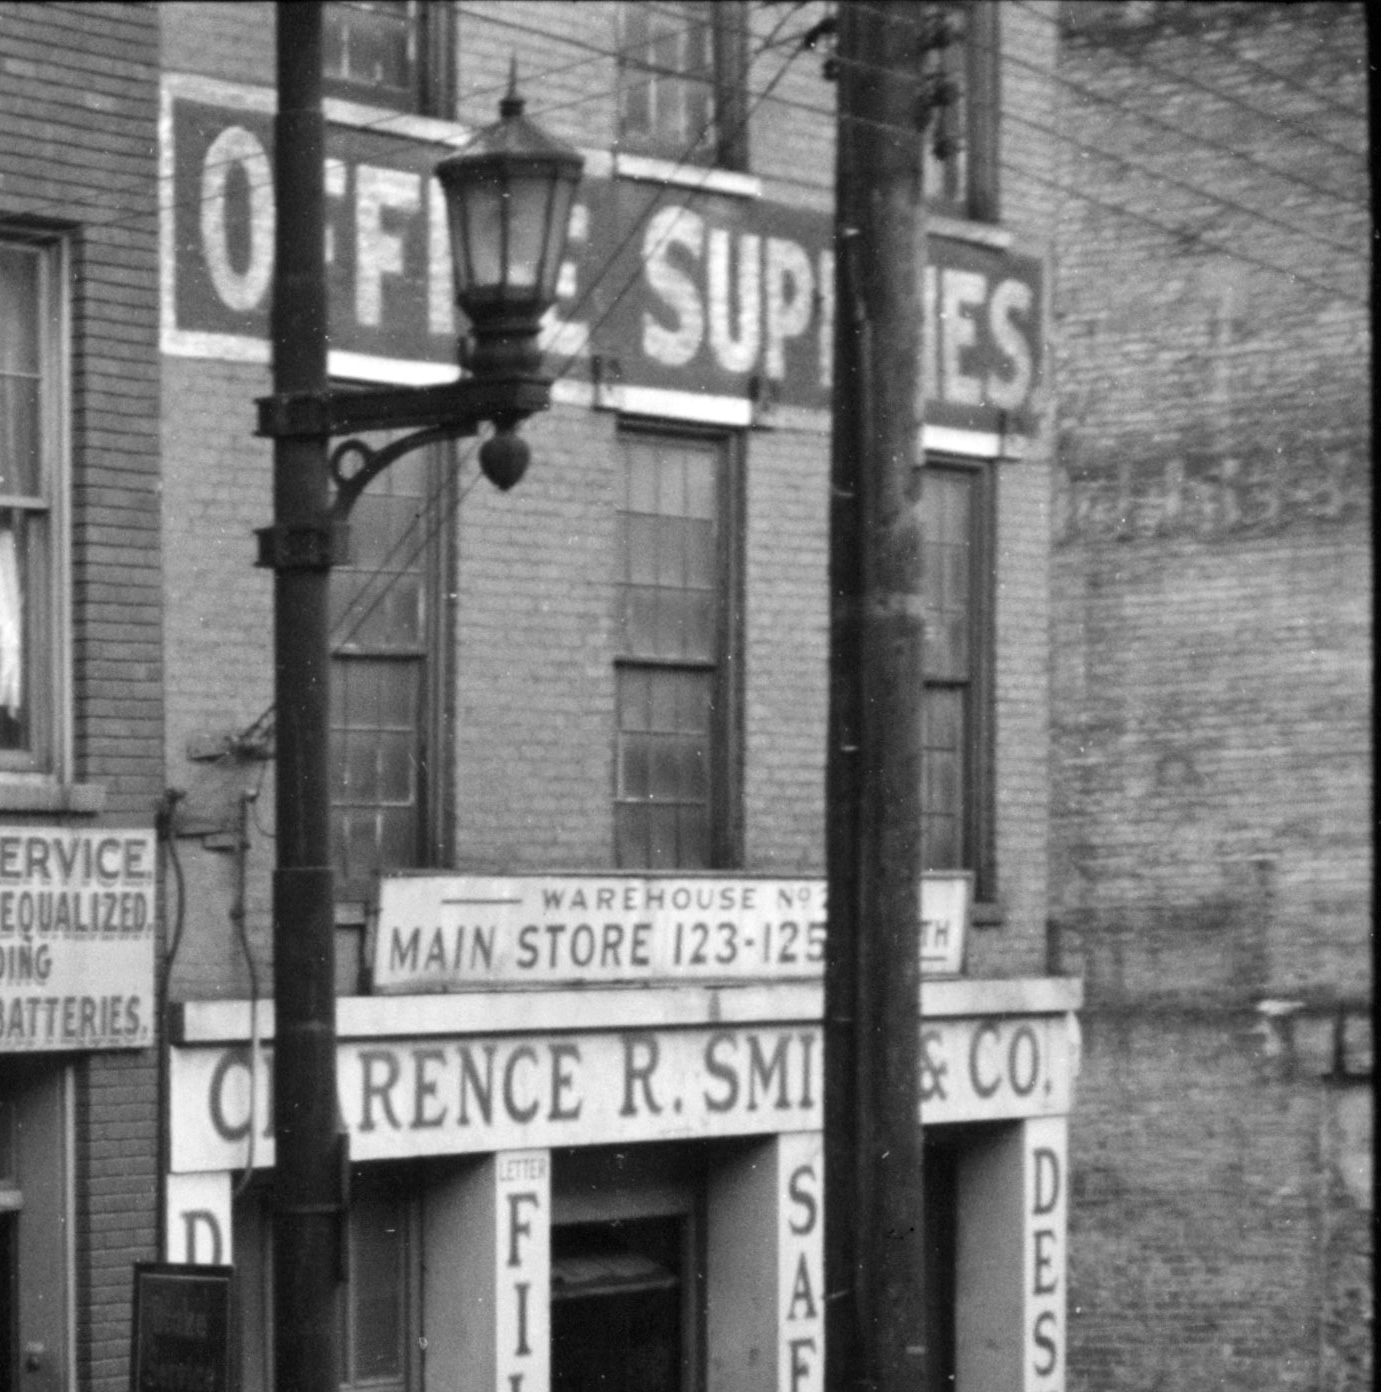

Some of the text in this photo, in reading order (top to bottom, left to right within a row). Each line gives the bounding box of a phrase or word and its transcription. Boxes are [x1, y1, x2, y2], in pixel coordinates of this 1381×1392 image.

[541, 885, 756, 912] WAREHOUSE
[388, 925, 495, 973] MAIN
[515, 923, 652, 968] STORE
[673, 921, 827, 965] 123-125
[968, 1022, 1053, 1100] CO.
